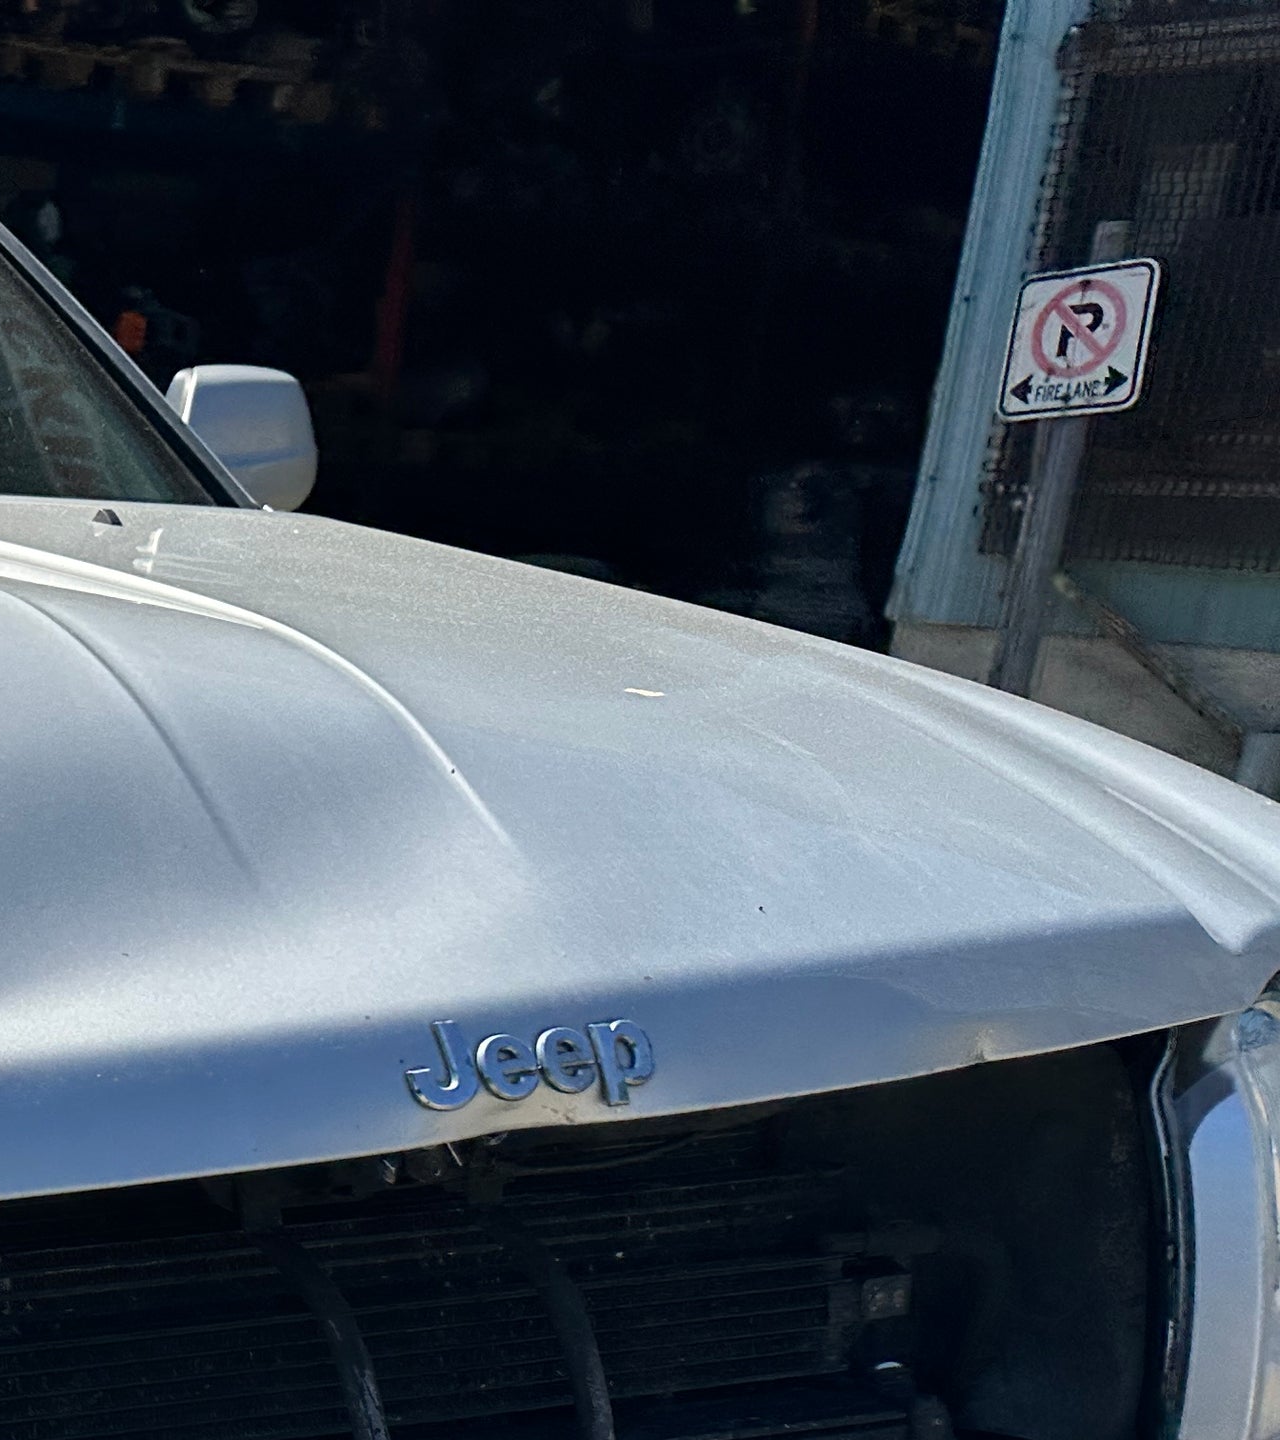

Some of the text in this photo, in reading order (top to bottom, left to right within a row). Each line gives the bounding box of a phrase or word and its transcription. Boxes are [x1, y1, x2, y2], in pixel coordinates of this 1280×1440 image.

[1034, 380, 1101, 401] FIRE LANE
[404, 1018, 656, 1112] Jeep
